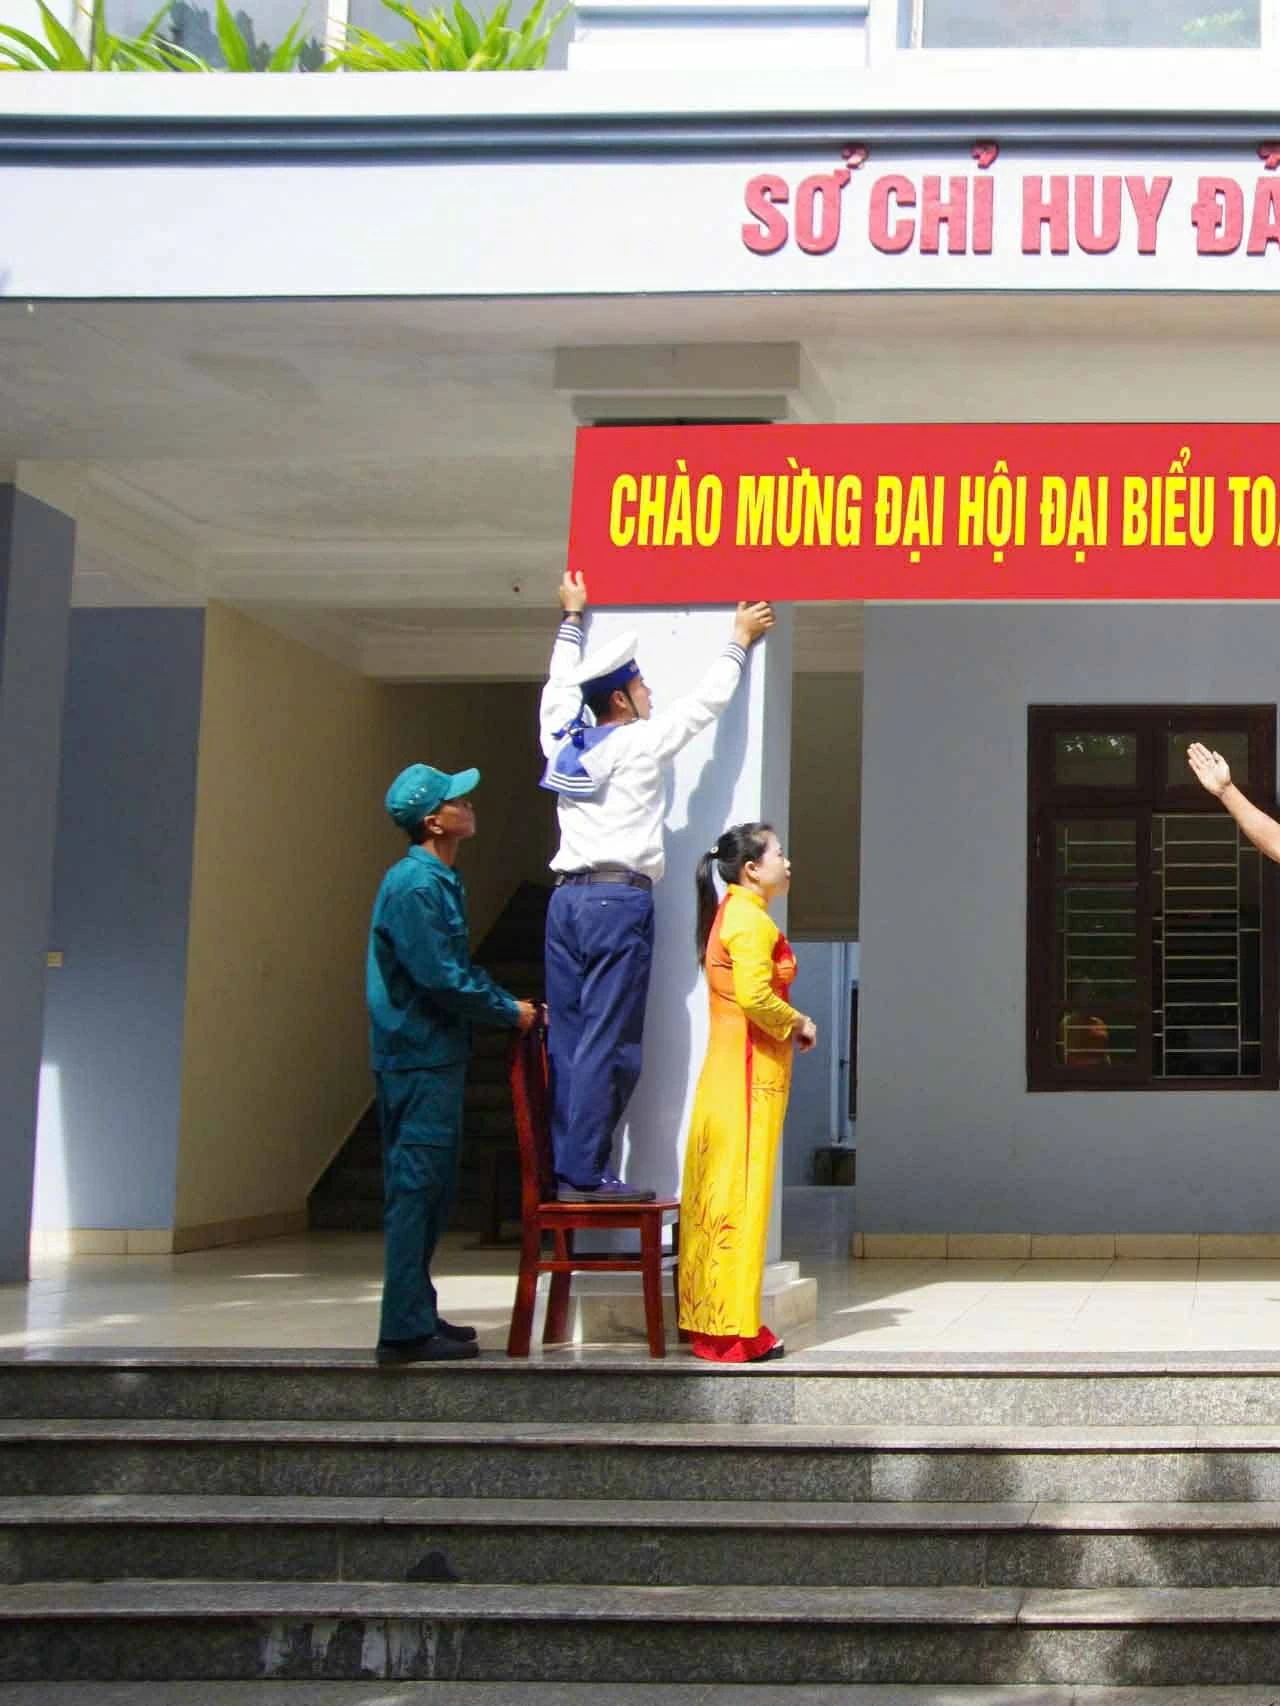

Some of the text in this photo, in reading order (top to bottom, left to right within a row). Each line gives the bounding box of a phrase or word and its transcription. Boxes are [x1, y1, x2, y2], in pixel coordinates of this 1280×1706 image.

[741, 142, 870, 256] SỞ
[868, 140, 999, 256] CHỈ
[1021, 175, 1173, 256] HUY
[609, 459, 723, 547] CHÀO
[735, 456, 862, 547] MỪNG
[874, 475, 945, 563] ĐẠI
[958, 460, 1027, 563] HỘI
[1039, 475, 1109, 563] ĐẠI
[1122, 446, 1215, 548] BIỂU
